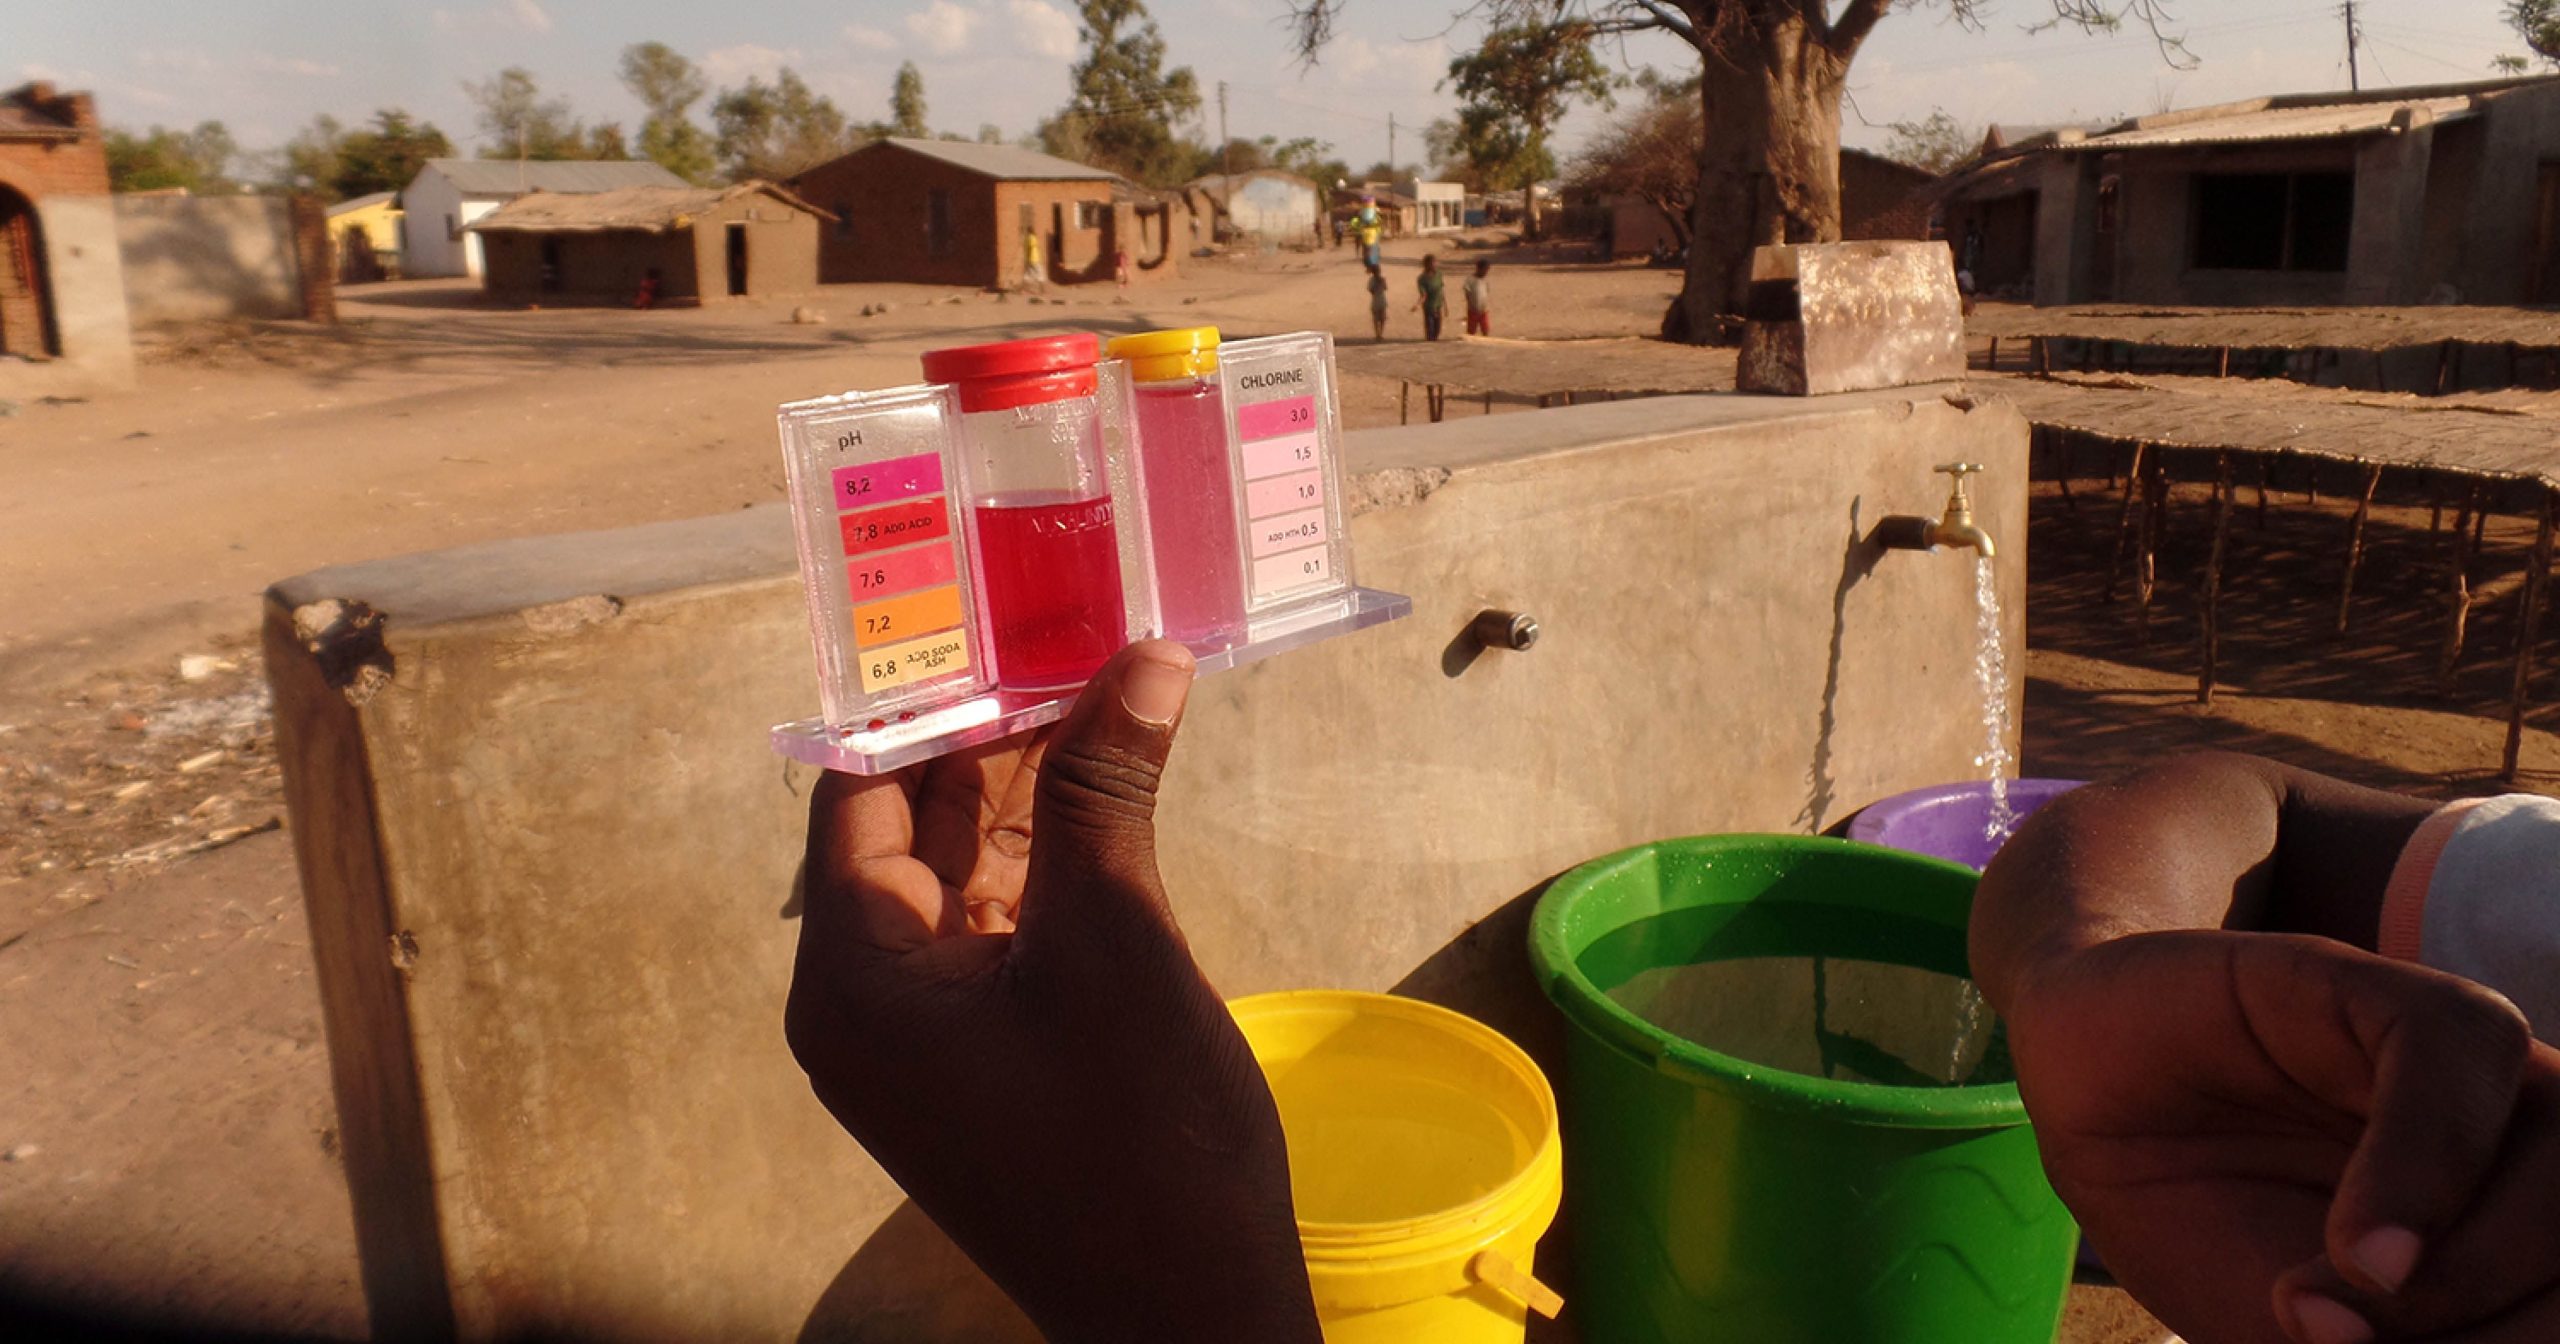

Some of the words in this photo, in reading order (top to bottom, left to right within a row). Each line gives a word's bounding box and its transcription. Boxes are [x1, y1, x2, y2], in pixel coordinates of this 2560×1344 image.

[1240, 368, 1303, 389] CHLORINE
[1290, 407, 1308, 422] 3,0
[838, 429, 862, 452] pH
[1295, 446, 1312, 461] 1,5
[846, 477, 871, 496] 8,2
[1299, 484, 1315, 499] 1,0
[854, 523, 878, 542] 7,8
[884, 522, 906, 535] ADD
[908, 516, 933, 530] ACID
[1301, 521, 1319, 536] 0,5
[1303, 559, 1320, 574] 0,1
[860, 569, 885, 588] 7,6
[866, 615, 891, 634] 7,2
[872, 660, 897, 678] 6,8
[931, 642, 960, 657] SODA
[924, 655, 946, 669] ASH
